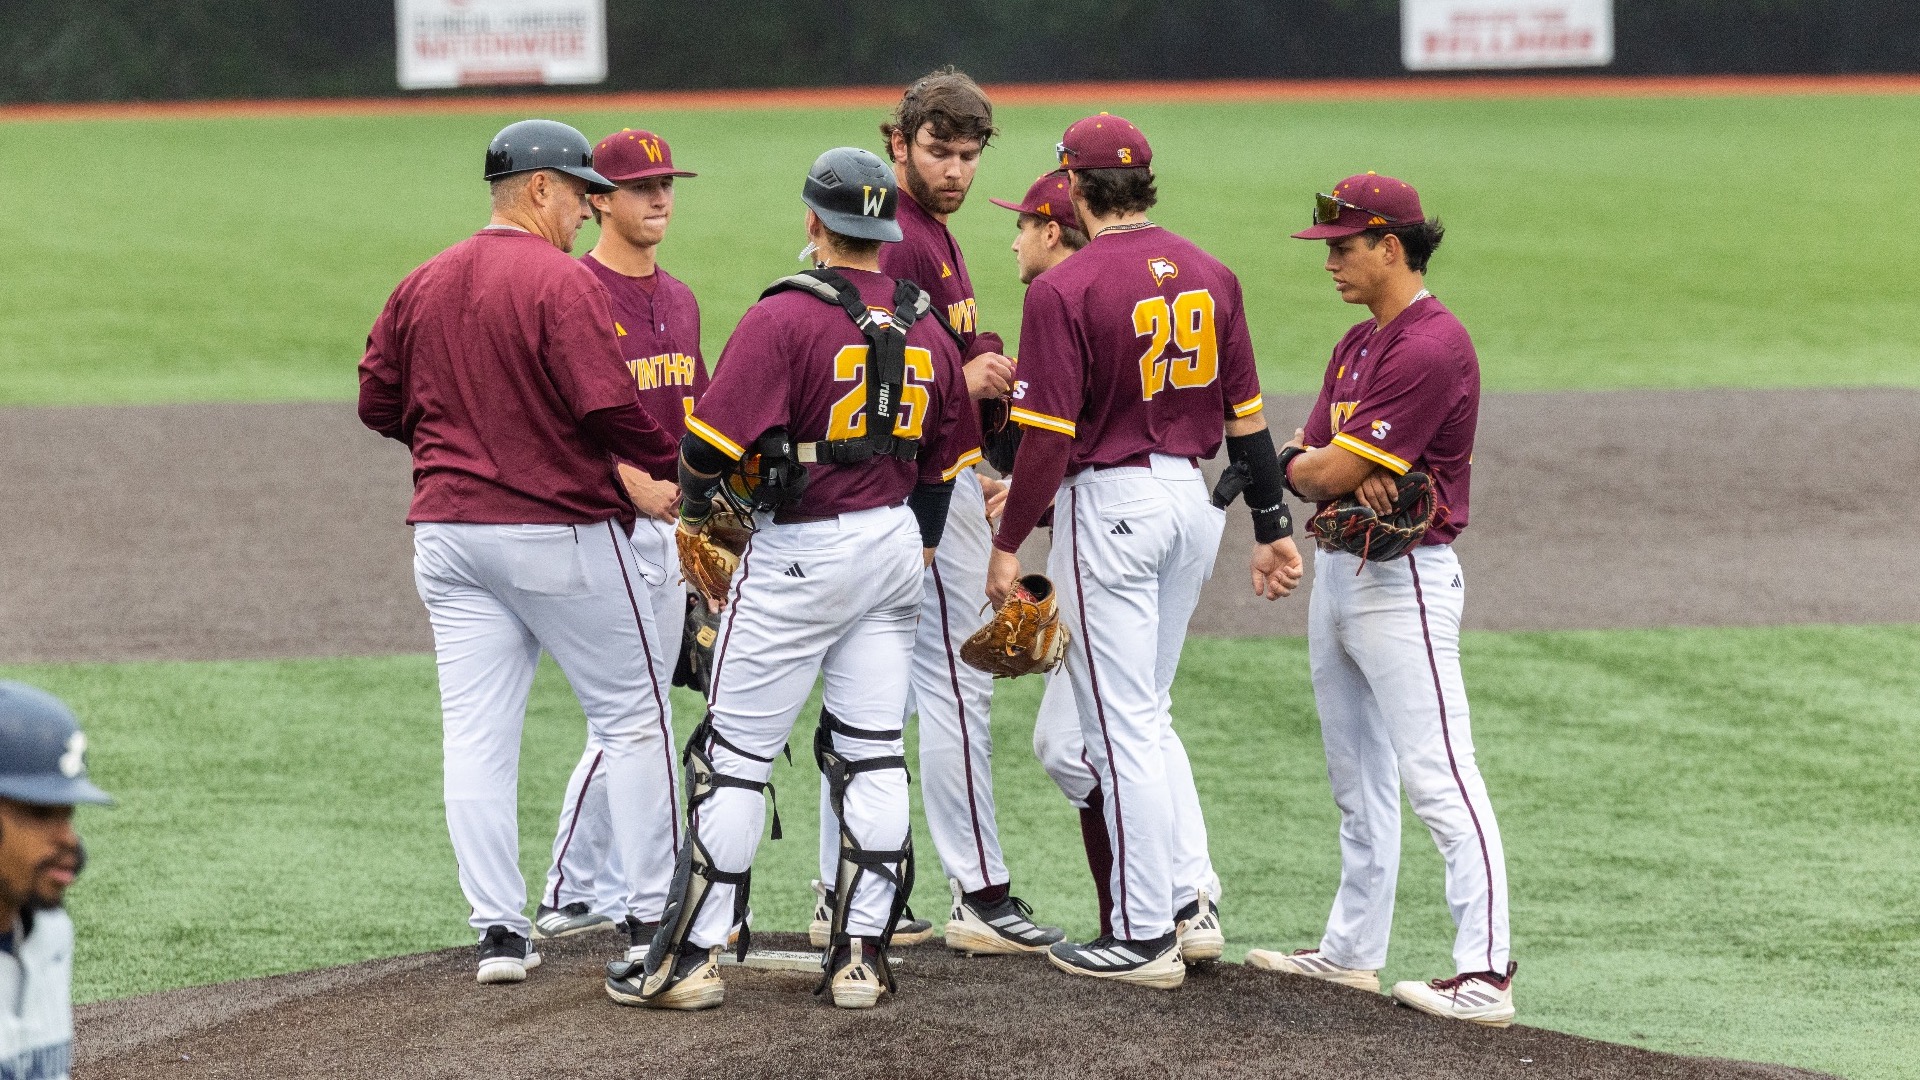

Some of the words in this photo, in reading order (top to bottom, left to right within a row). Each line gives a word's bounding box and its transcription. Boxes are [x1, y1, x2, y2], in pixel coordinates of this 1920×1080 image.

[639, 138, 663, 162] W
[862, 185, 888, 218] W
[1131, 288, 1219, 402] 29
[877, 381, 890, 418] rucci
[1012, 380, 1029, 399] S
[1371, 419, 1392, 440] S
